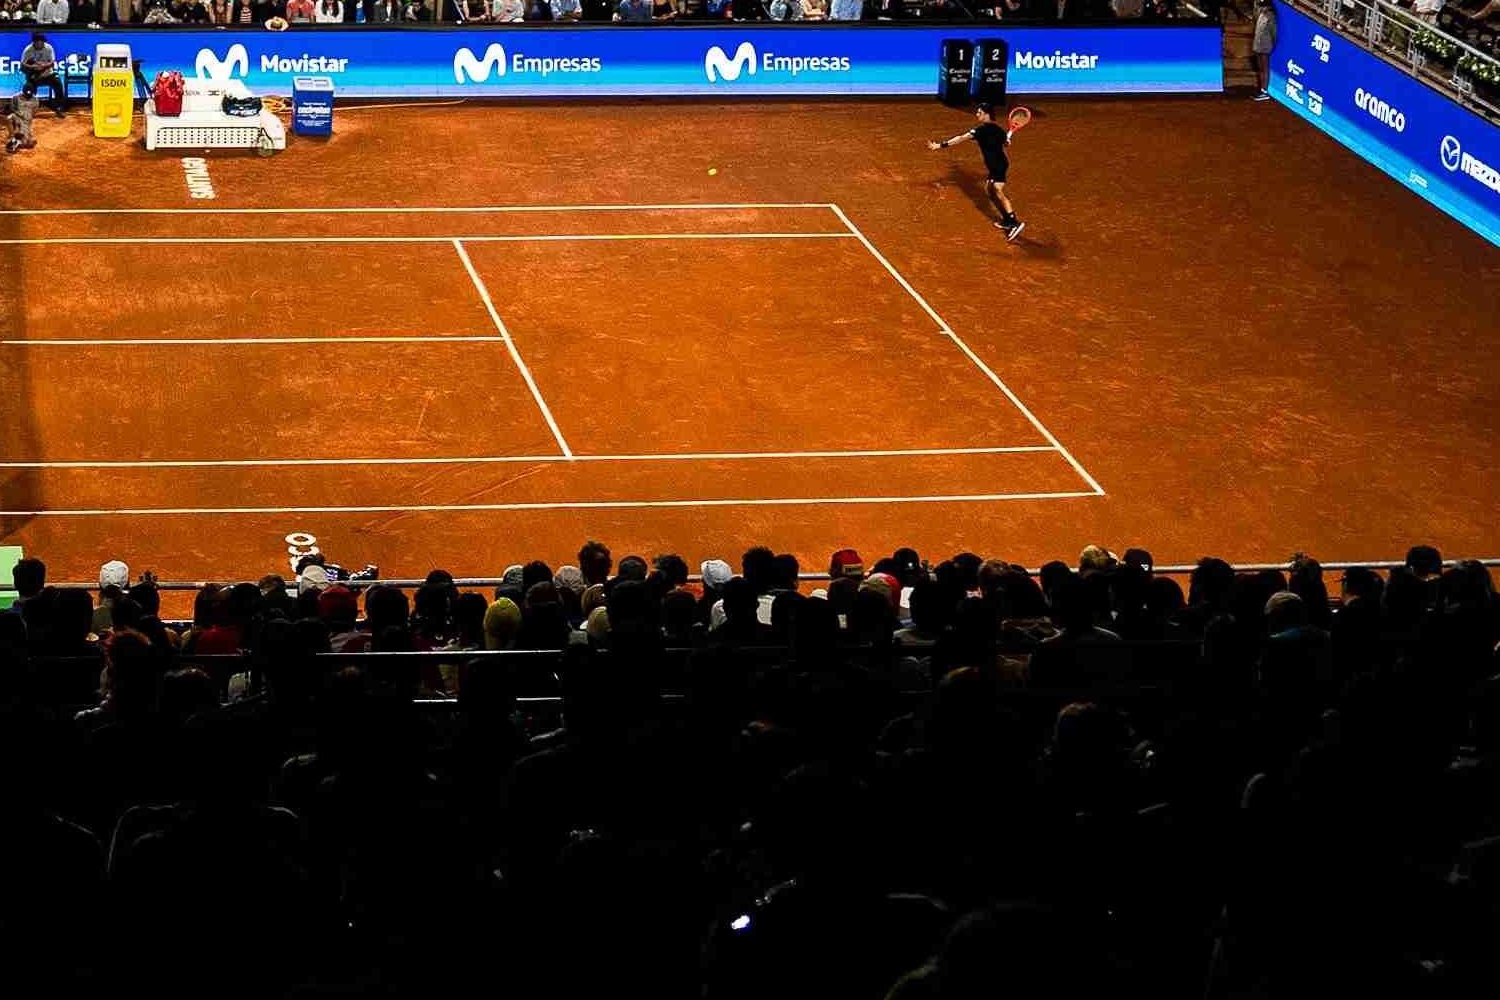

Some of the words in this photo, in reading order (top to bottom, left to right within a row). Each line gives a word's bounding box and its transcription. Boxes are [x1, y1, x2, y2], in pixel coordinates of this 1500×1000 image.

[261, 54, 348, 73] Movistar
[763, 53, 849, 74] Empresas
[992, 49, 1000, 60] 2
[1015, 51, 1099, 69] Movistar
[512, 54, 601, 75] Empresas
[100, 79, 126, 87] ISDIN
[1355, 88, 1406, 132] aramco
